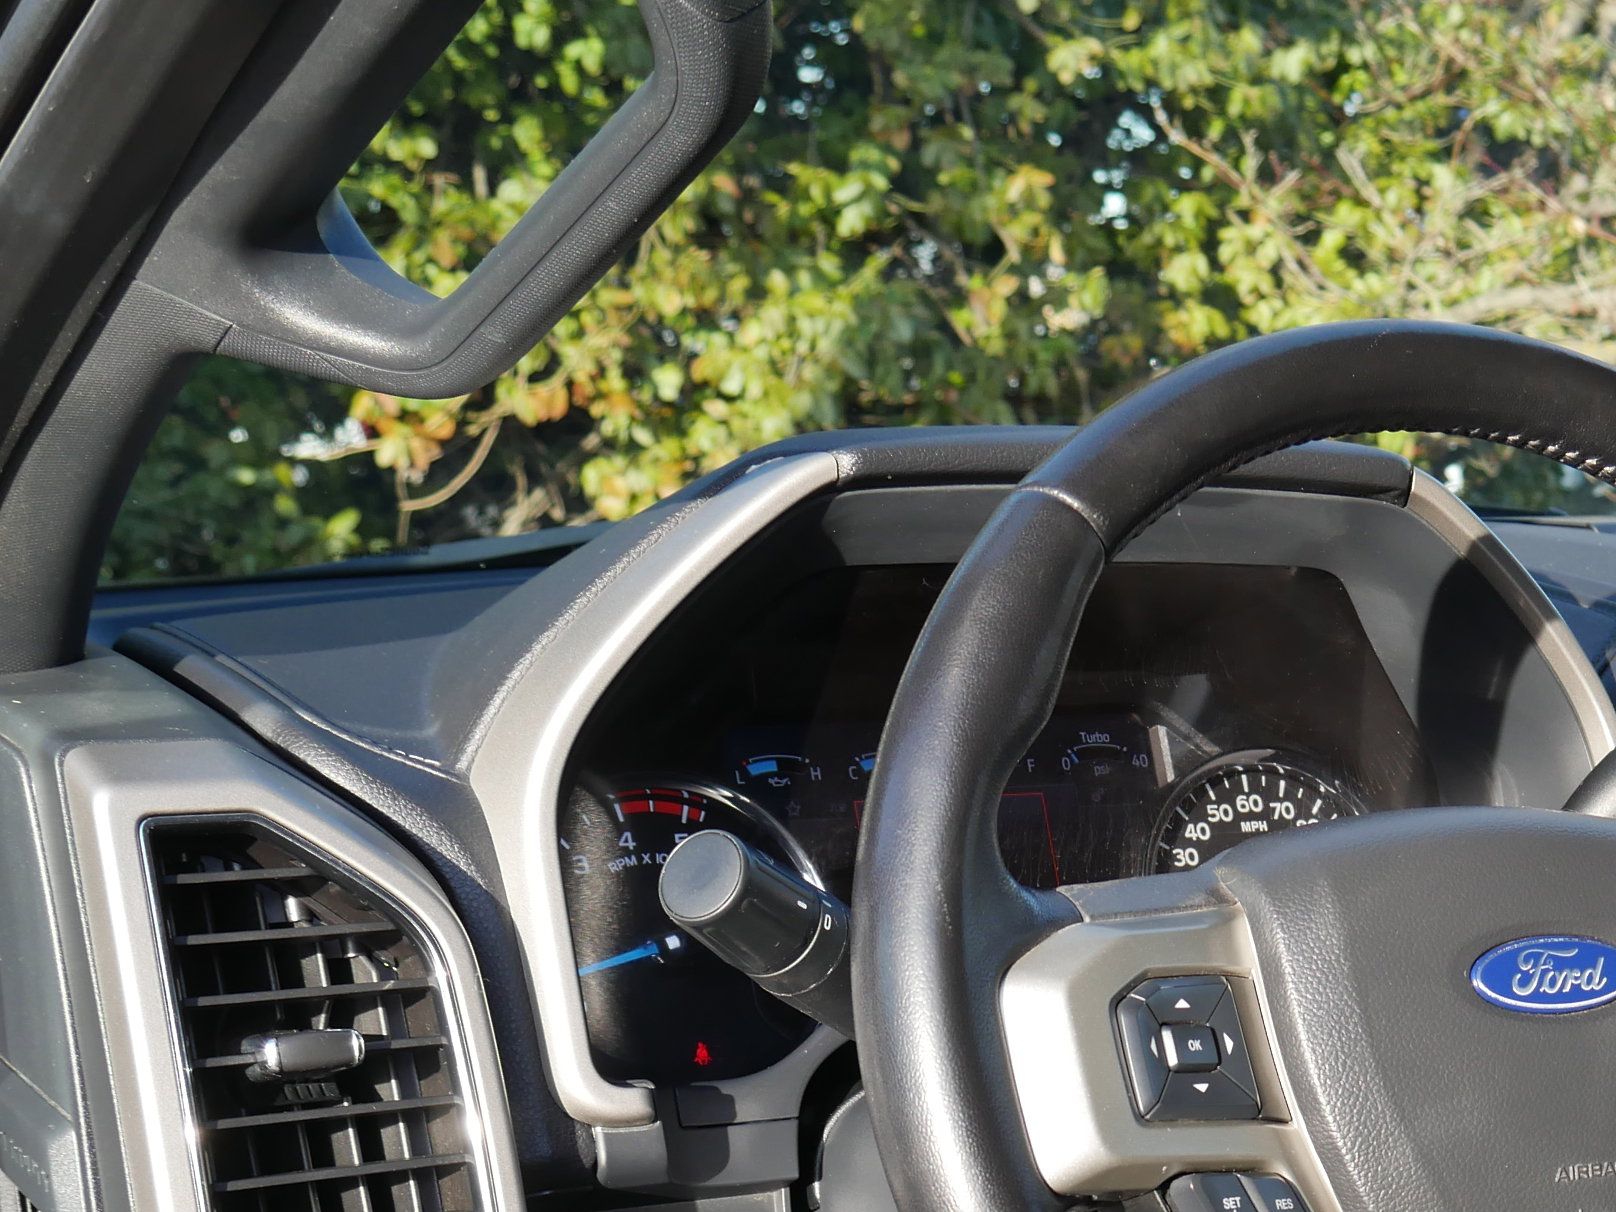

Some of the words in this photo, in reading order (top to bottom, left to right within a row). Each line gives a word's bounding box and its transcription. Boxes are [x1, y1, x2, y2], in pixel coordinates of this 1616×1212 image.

[1079, 731, 1110, 743] Turbo
[1026, 758, 1036, 773] F
[1061, 757, 1071, 771] 0
[1131, 754, 1148, 768] 40
[735, 770, 746, 785] L
[810, 766, 822, 781] H
[848, 765, 859, 780] C
[1236, 794, 1263, 813] 60
[1269, 801, 1295, 820] 70
[1206, 804, 1233, 823] 50
[1184, 822, 1211, 841] 40
[1240, 820, 1268, 833] MPH
[618, 831, 636, 850] 4
[573, 854, 590, 875] 3
[607, 853, 638, 874] RPM
[1172, 848, 1199, 867] 30
[1512, 948, 1607, 996] Ford
[1188, 1039, 1203, 1051] OK
[1223, 1196, 1241, 1210] SET
[1275, 1198, 1294, 1210] RES
